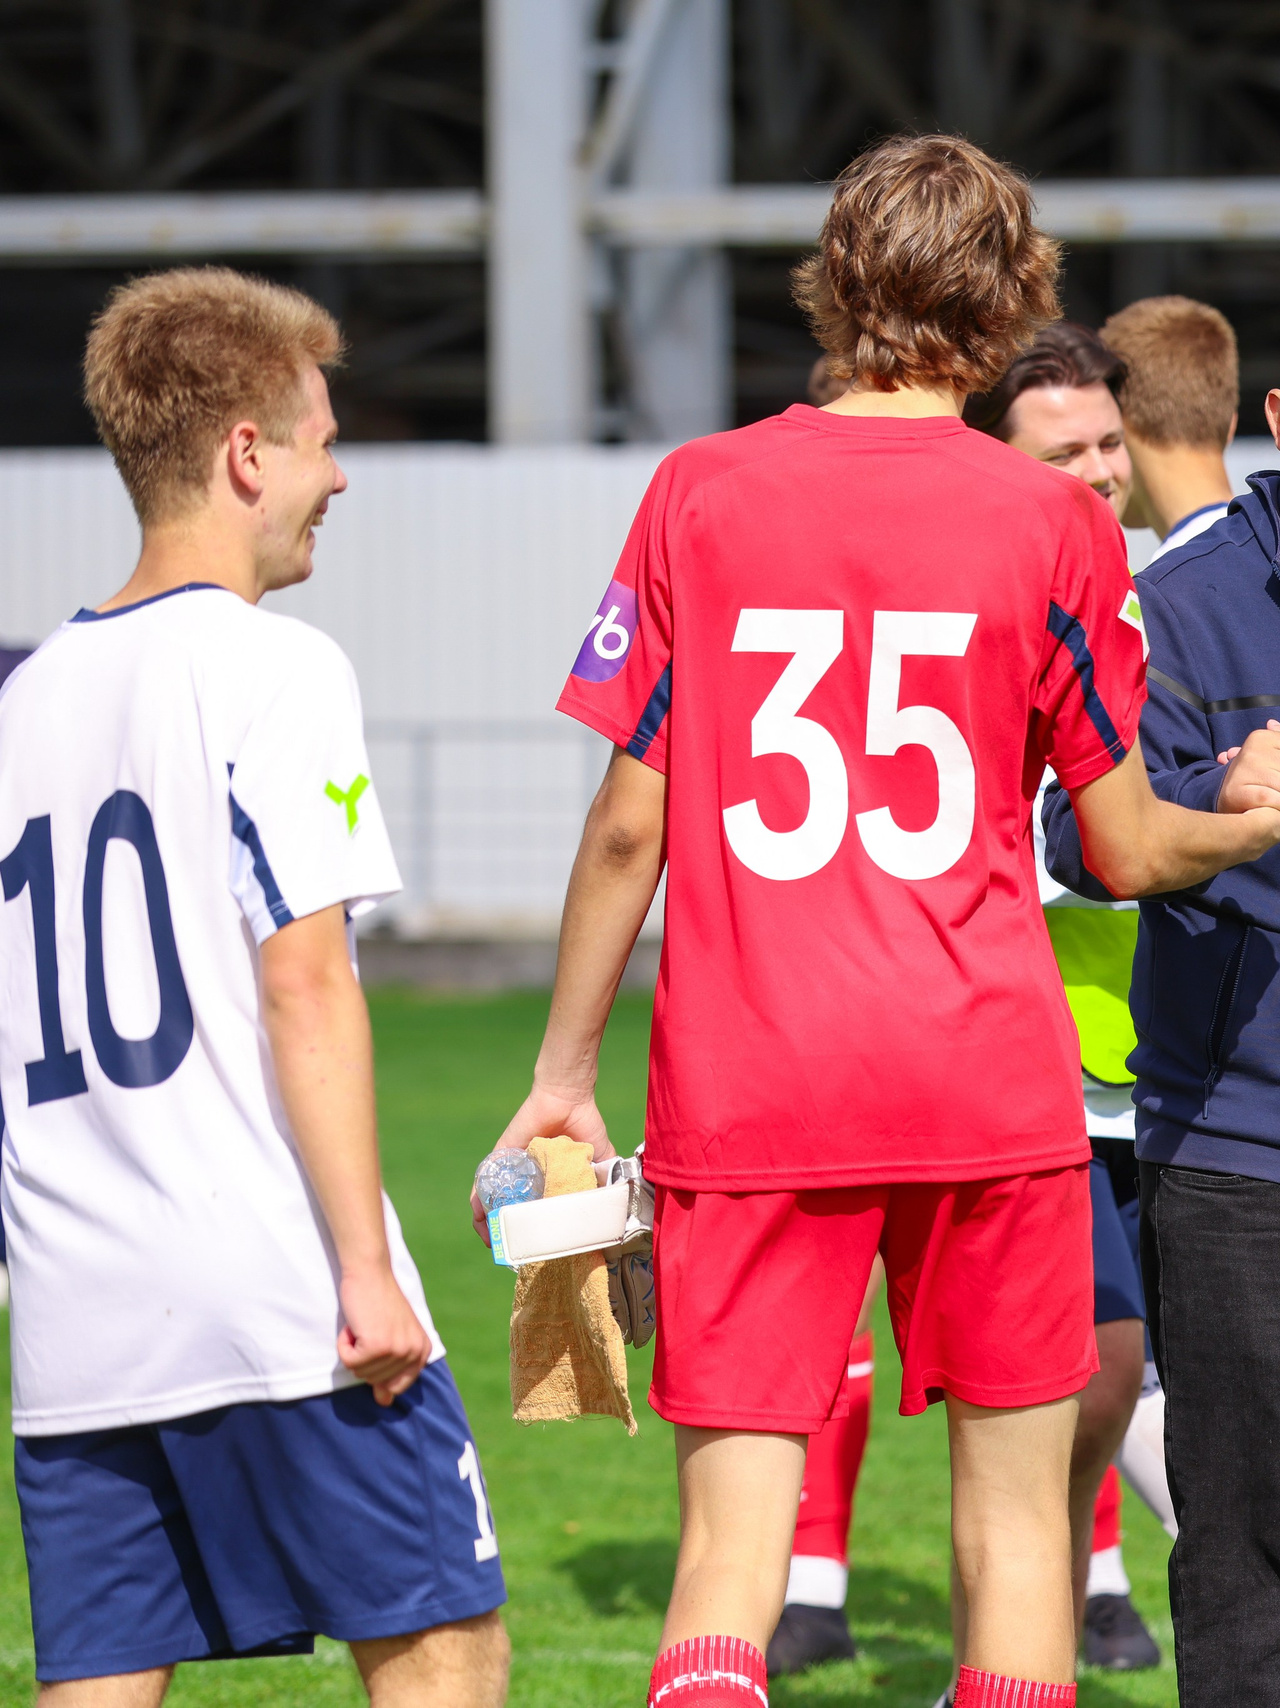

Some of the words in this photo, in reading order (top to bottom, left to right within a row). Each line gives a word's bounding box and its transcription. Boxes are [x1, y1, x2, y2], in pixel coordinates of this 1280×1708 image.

[722, 608, 978, 881] 35
[0, 789, 194, 1107] 10
[490, 1216, 501, 1241] ONE
[493, 1243, 505, 1259] BE
[656, 1670, 752, 1703] KELME
